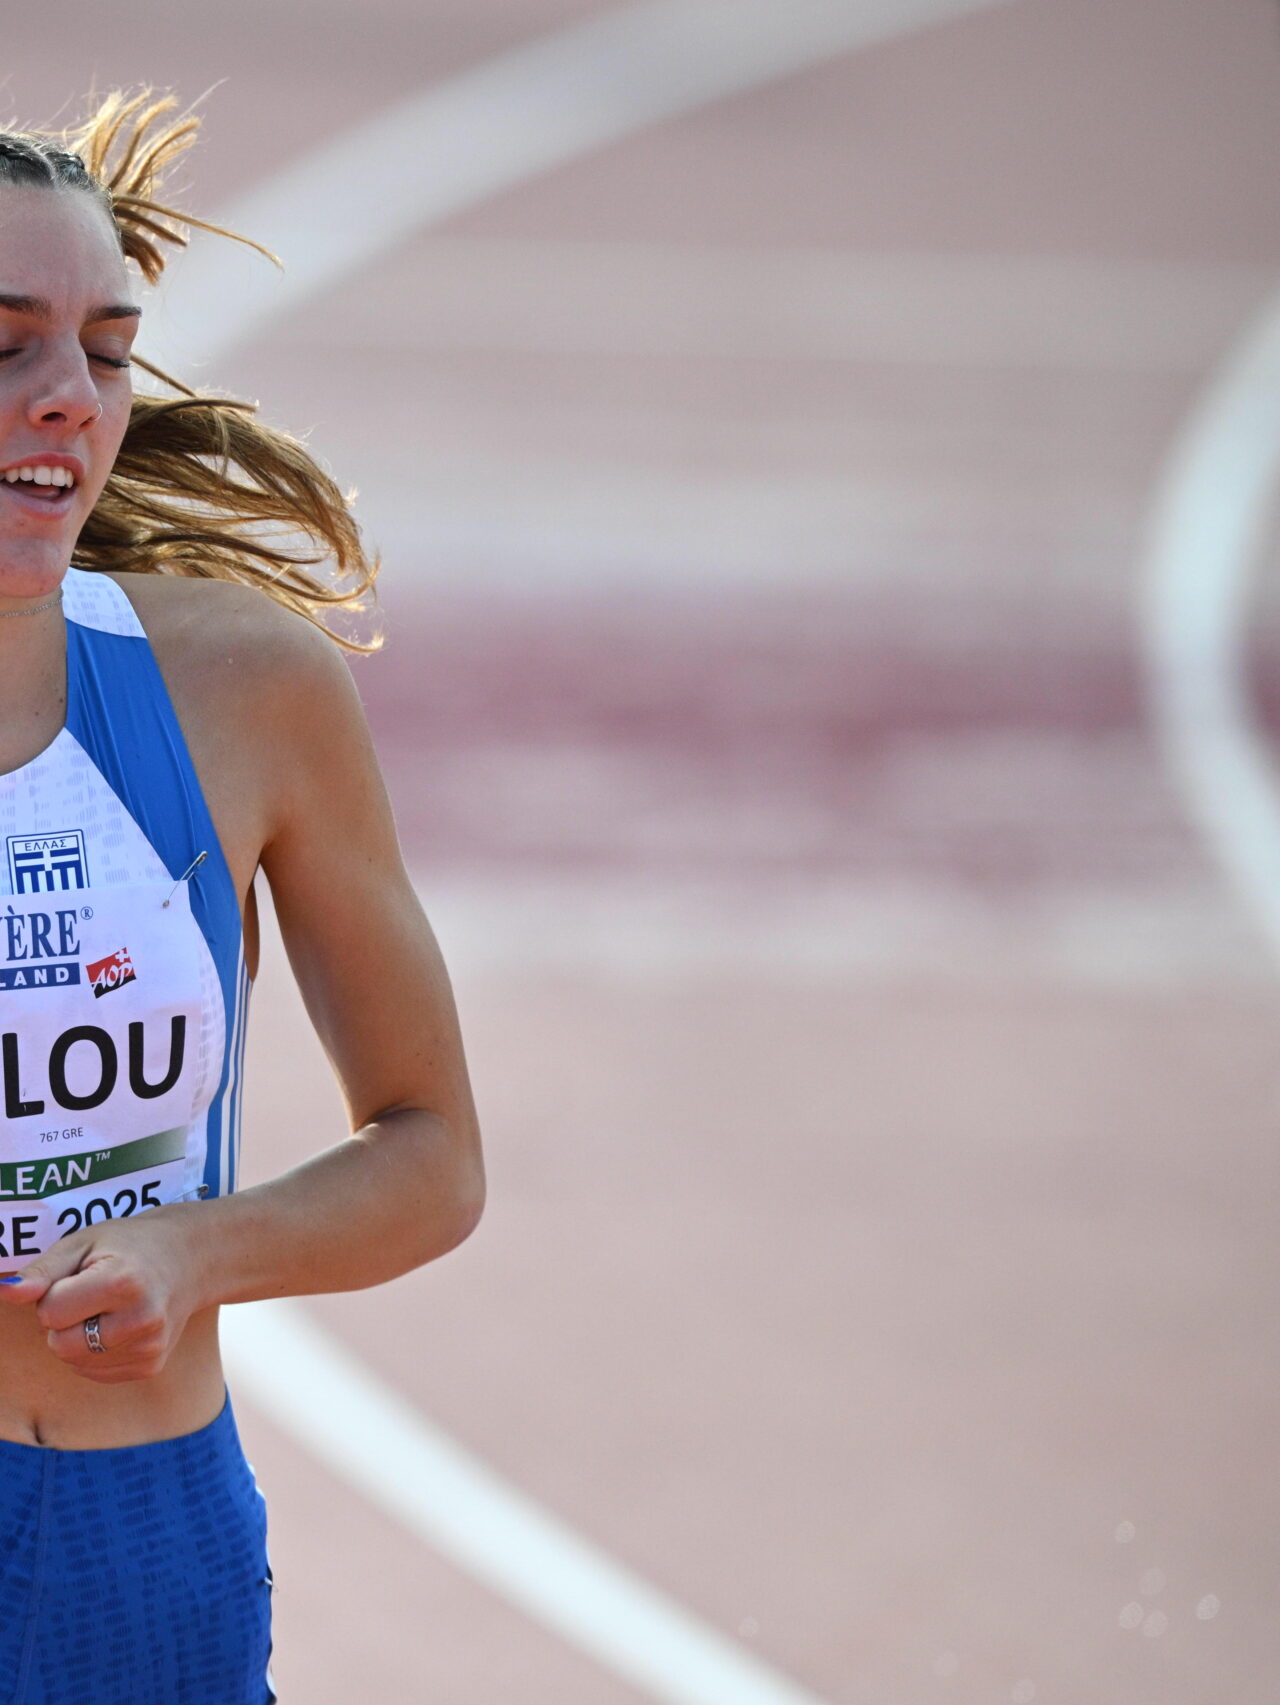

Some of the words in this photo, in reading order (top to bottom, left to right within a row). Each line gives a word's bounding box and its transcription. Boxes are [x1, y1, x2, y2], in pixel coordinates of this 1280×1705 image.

[24, 838, 67, 852] ΕΛΛΑΣ
[90, 961, 134, 995] AOP
[40, 1131, 59, 1143] 767
[62, 1127, 84, 1140] GRE
